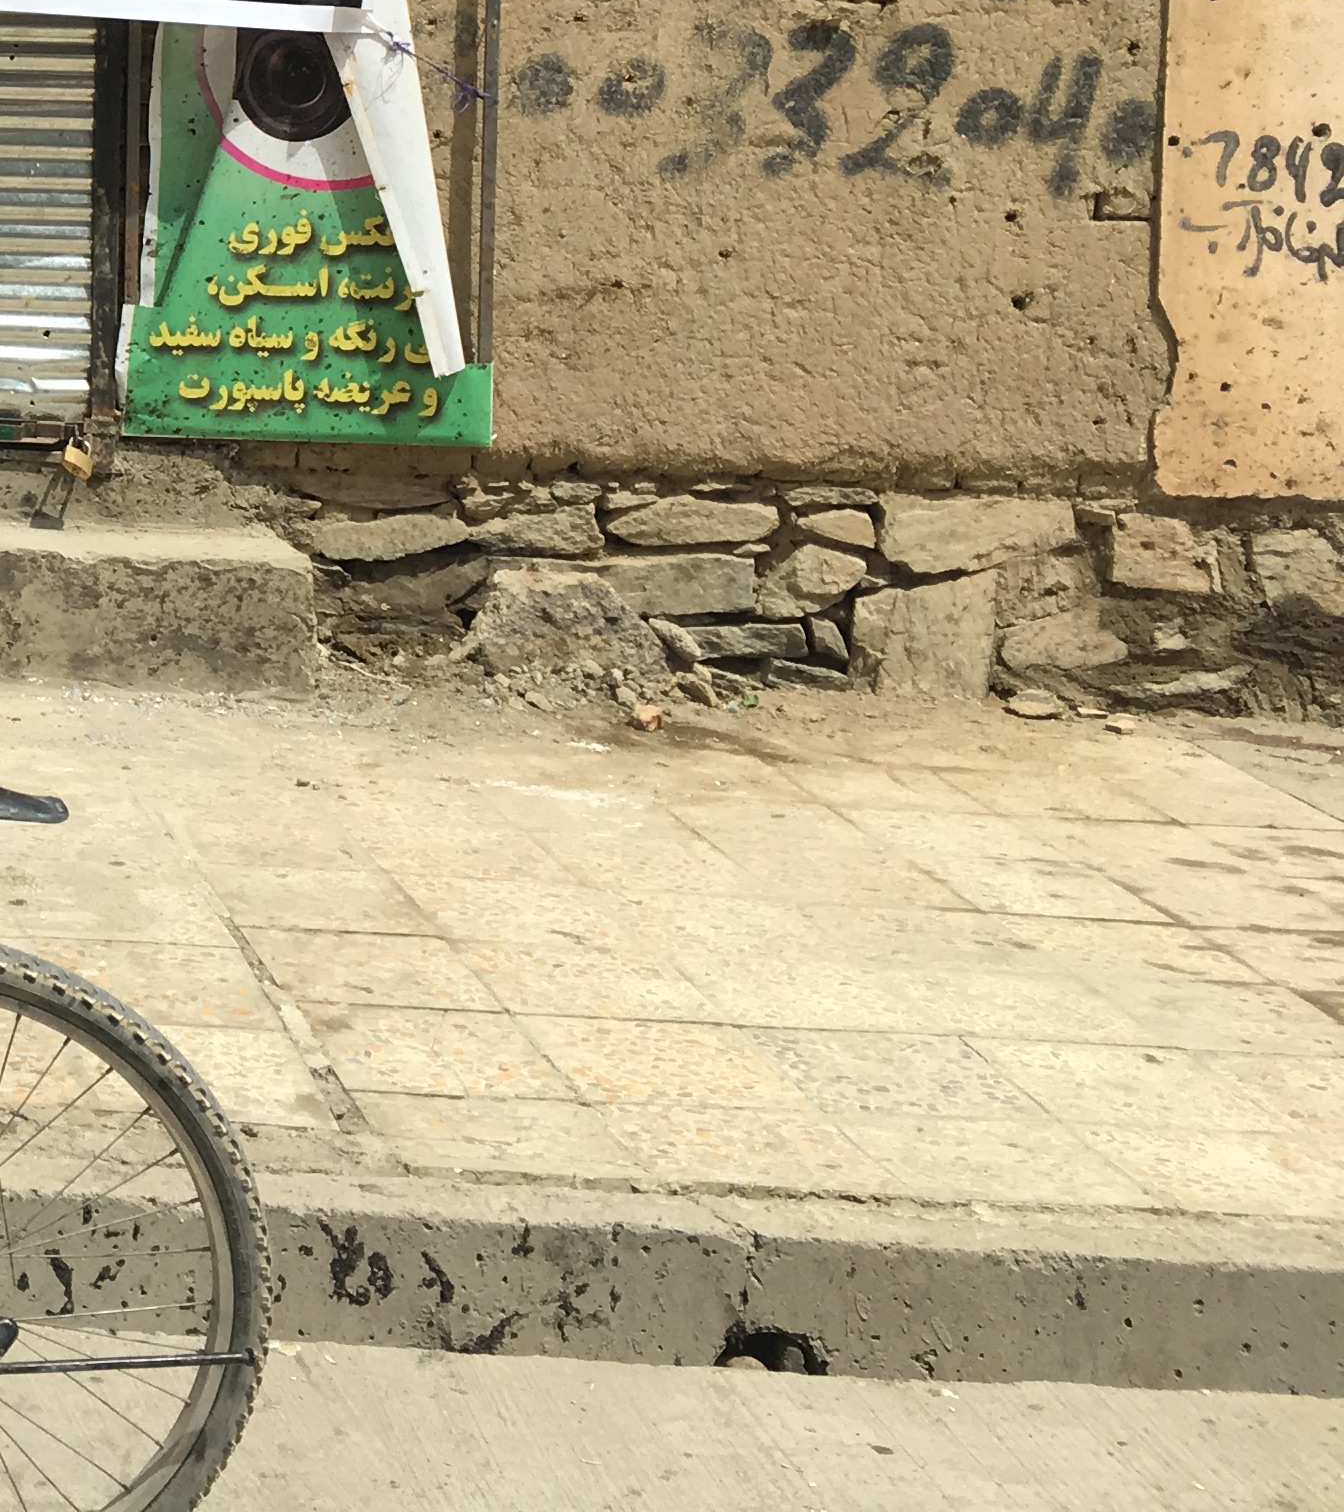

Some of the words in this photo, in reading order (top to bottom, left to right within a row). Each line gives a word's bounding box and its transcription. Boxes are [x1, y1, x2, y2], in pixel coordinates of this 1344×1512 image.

[228, 208, 312, 256] فوری
[148, 315, 222, 357] سفید
[228, 315, 294, 357] سیاه
[304, 330, 320, 361] و
[327, 318, 397, 363] رنگه
[178, 368, 306, 414] پاسپورت
[312, 370, 411, 415] عریضه
[418, 385, 439, 416] و
